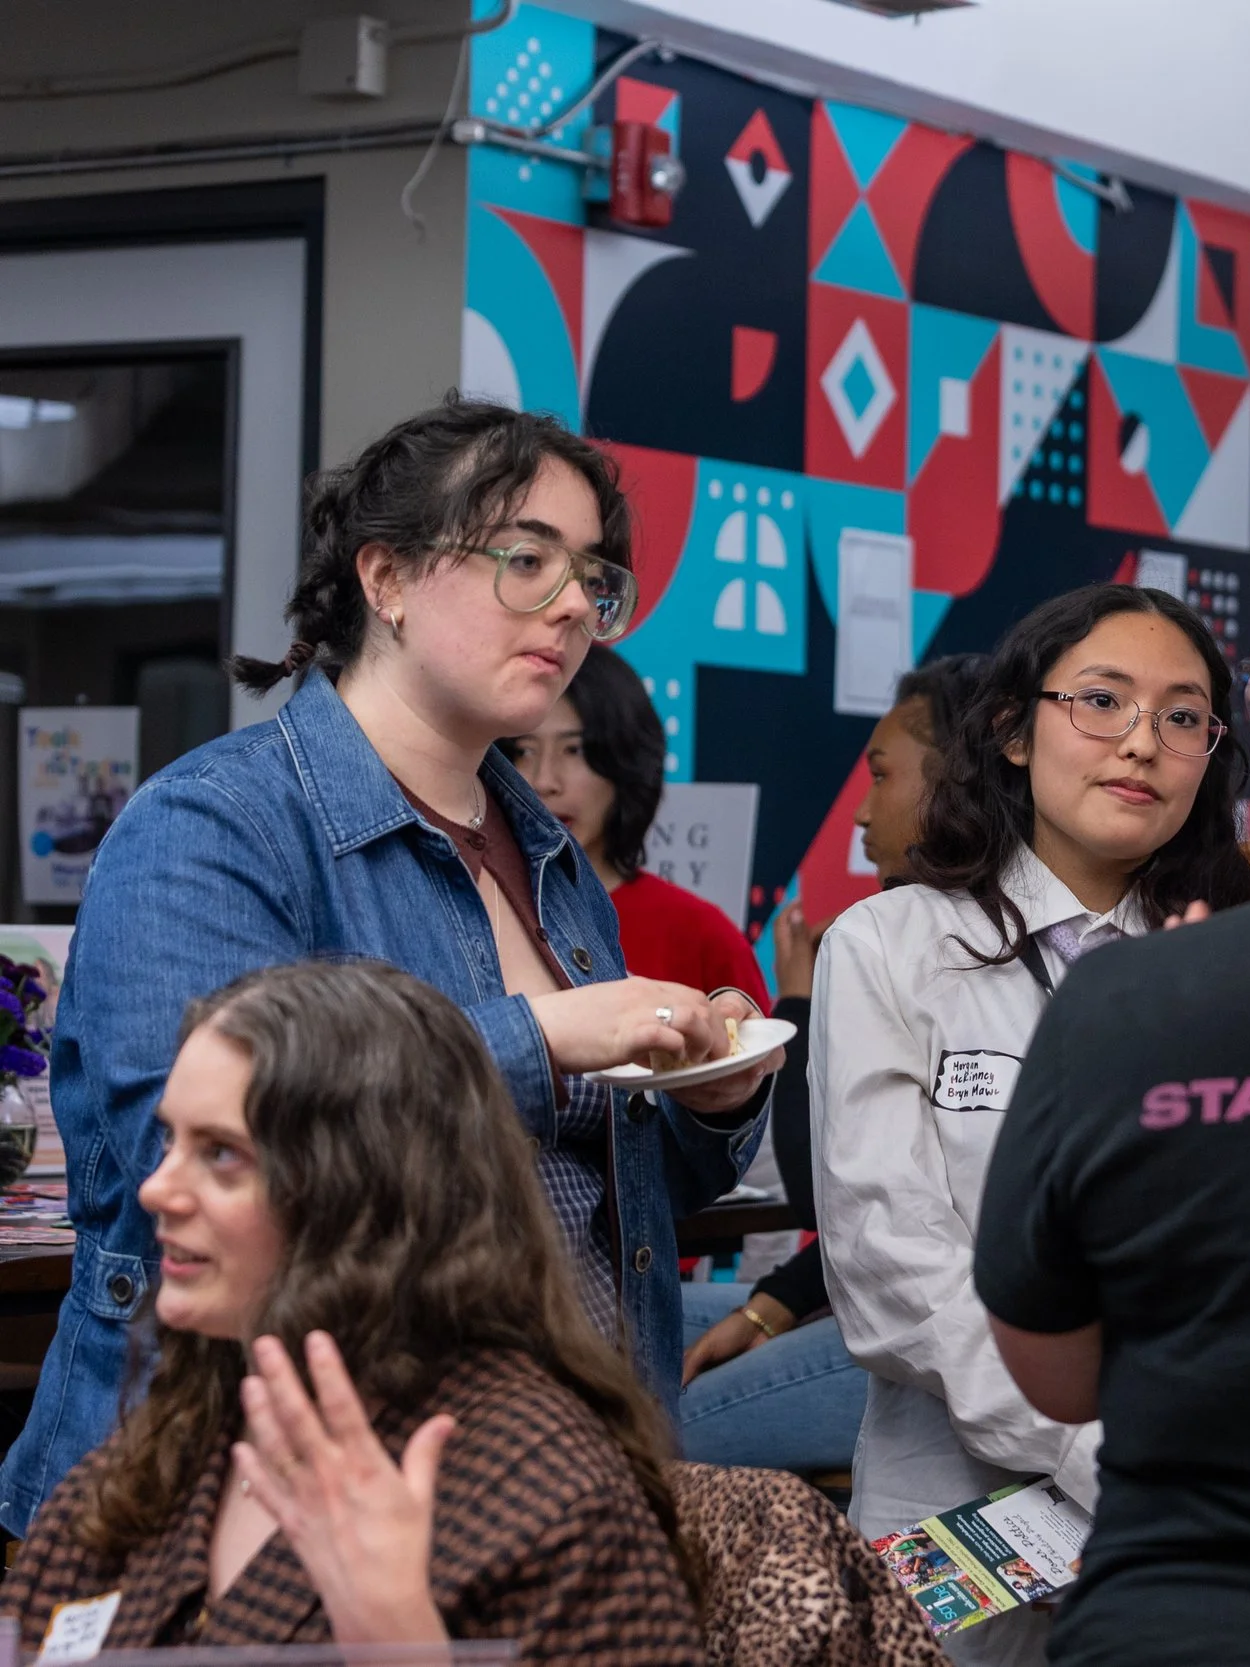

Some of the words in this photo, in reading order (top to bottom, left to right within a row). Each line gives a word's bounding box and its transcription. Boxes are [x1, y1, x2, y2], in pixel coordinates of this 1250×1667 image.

[953, 1061, 979, 1072] Morgan
[950, 1071, 995, 1085] McKinney
[947, 1087, 969, 1101] Bryn
[1004, 1516, 1033, 1547] Politics
[1037, 1549, 1063, 1574] Power
